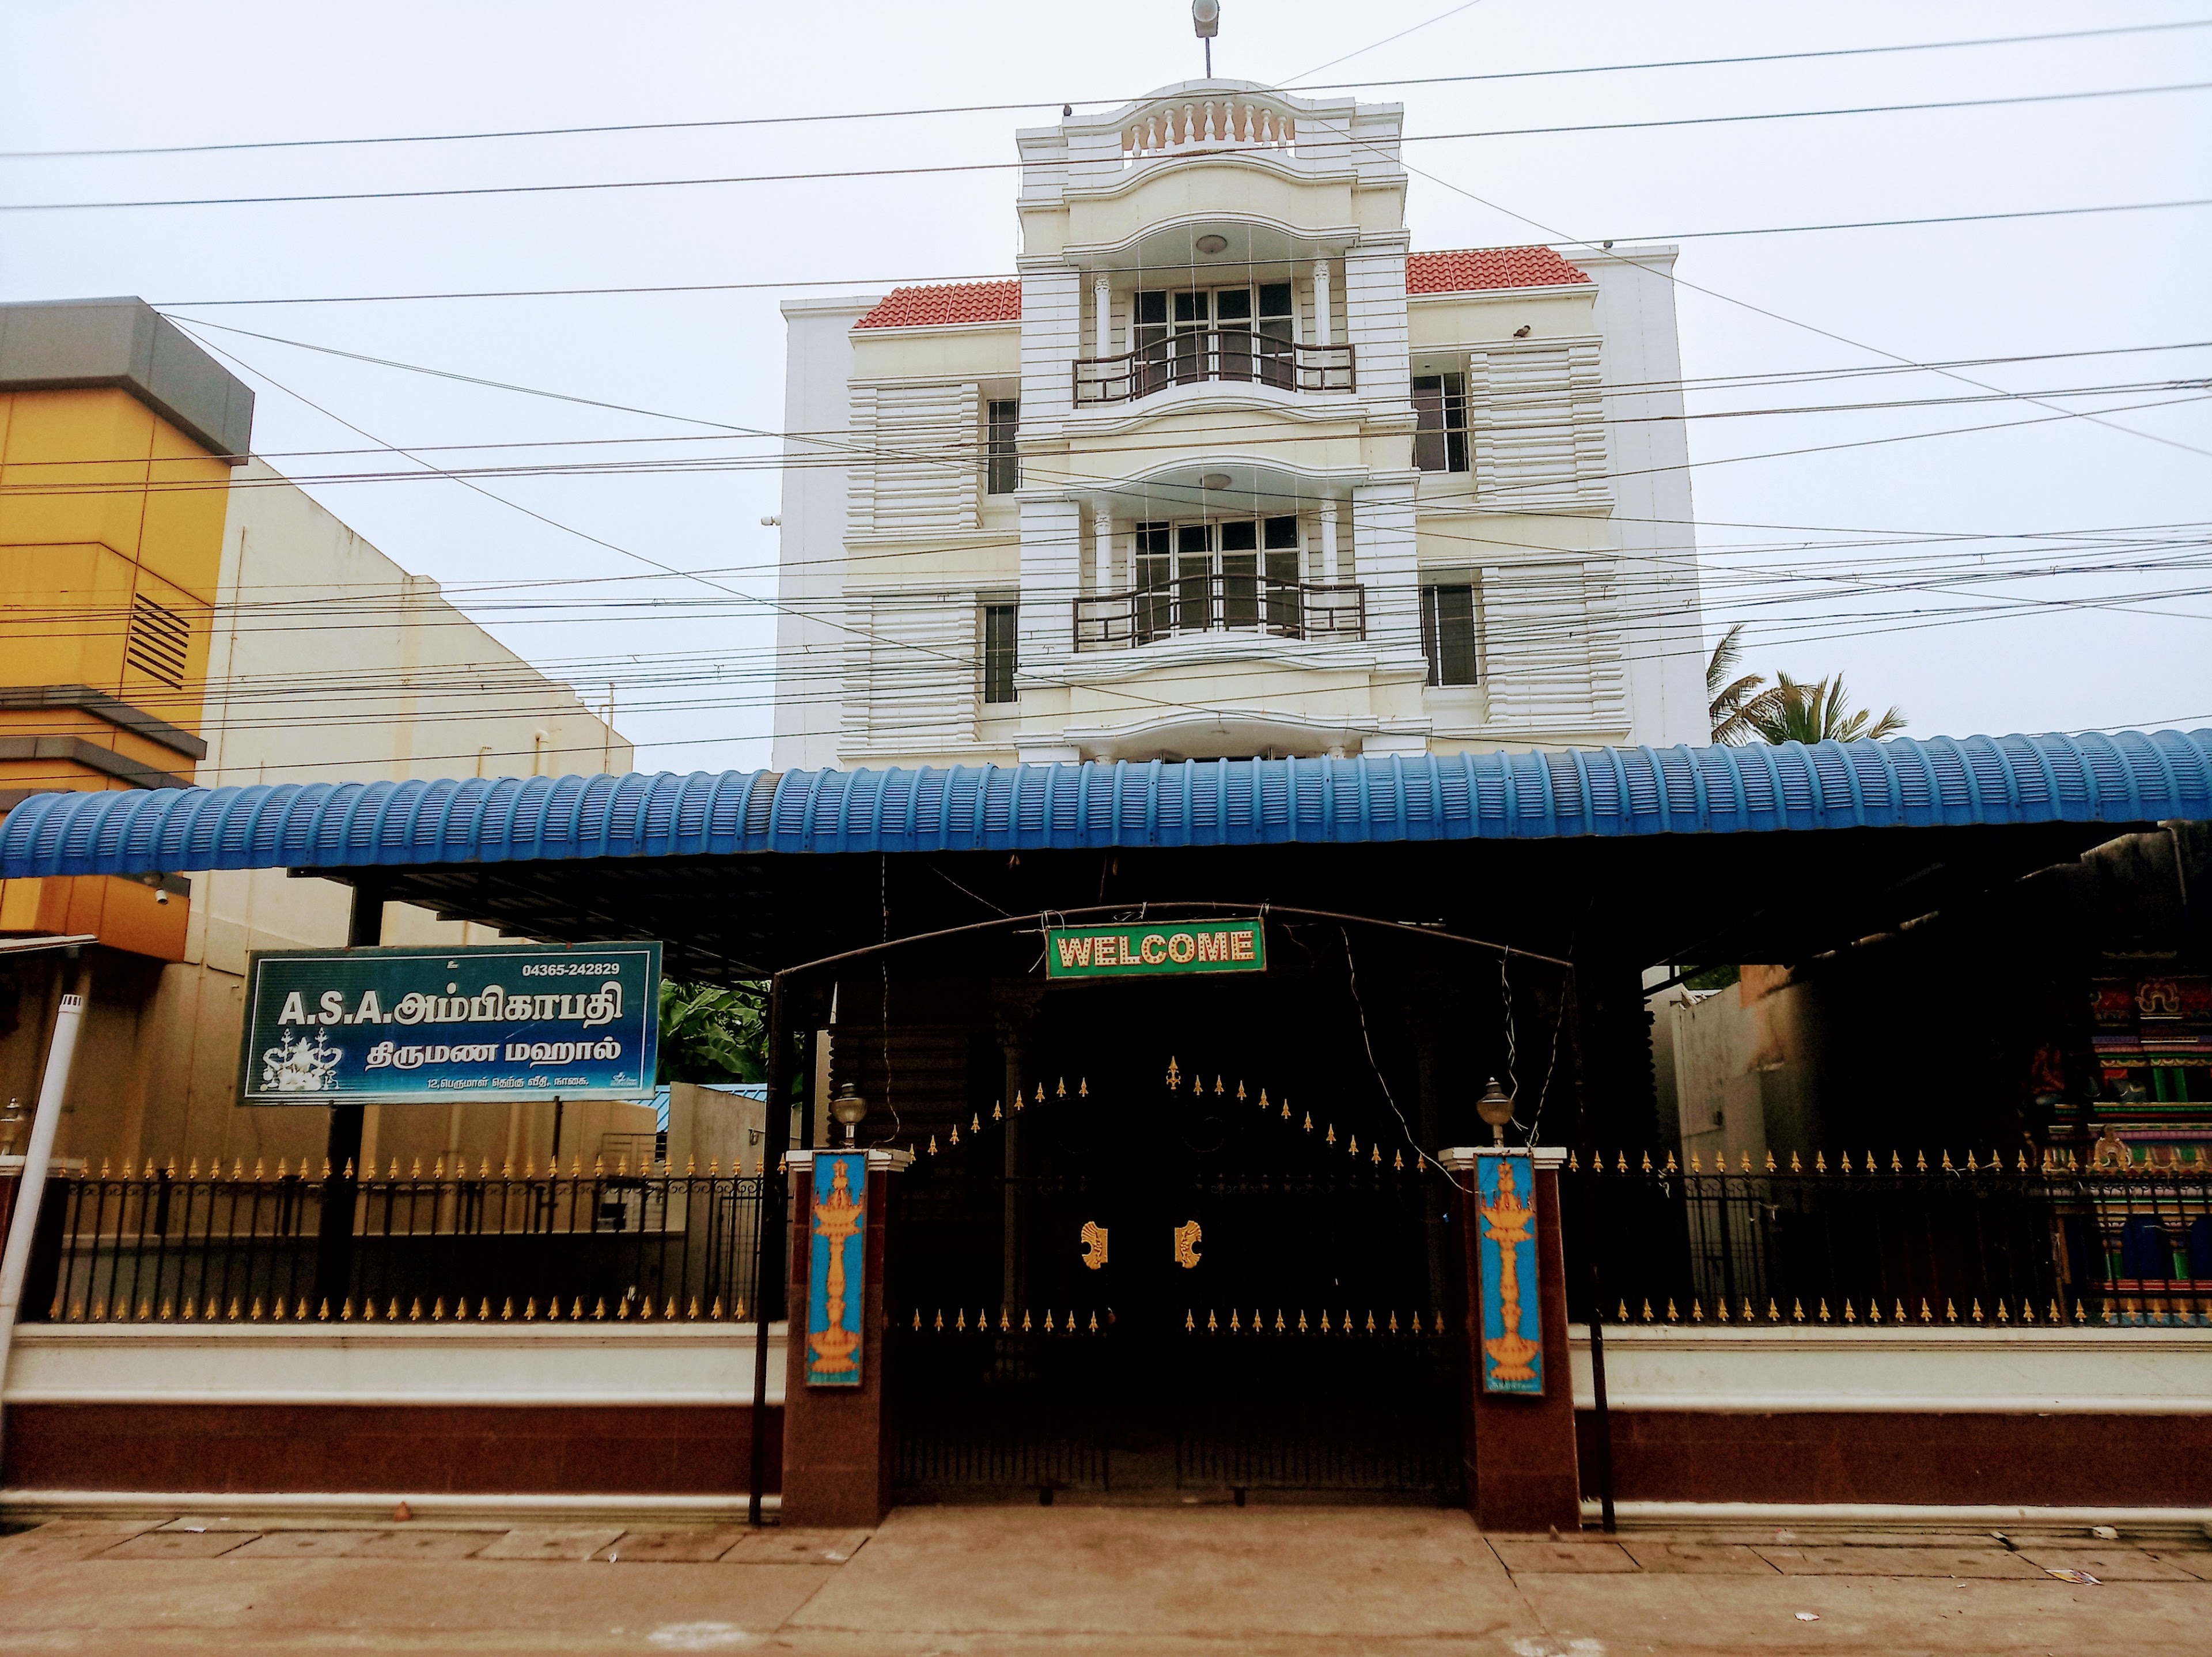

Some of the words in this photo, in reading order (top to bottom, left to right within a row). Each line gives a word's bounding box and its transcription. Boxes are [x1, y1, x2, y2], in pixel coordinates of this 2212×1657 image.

[1057, 930, 1256, 967] WELCOME
[522, 963, 620, 977] 04365-242829
[365, 1041, 499, 1072] திருமண
[505, 1036, 622, 1069] மஹால்
